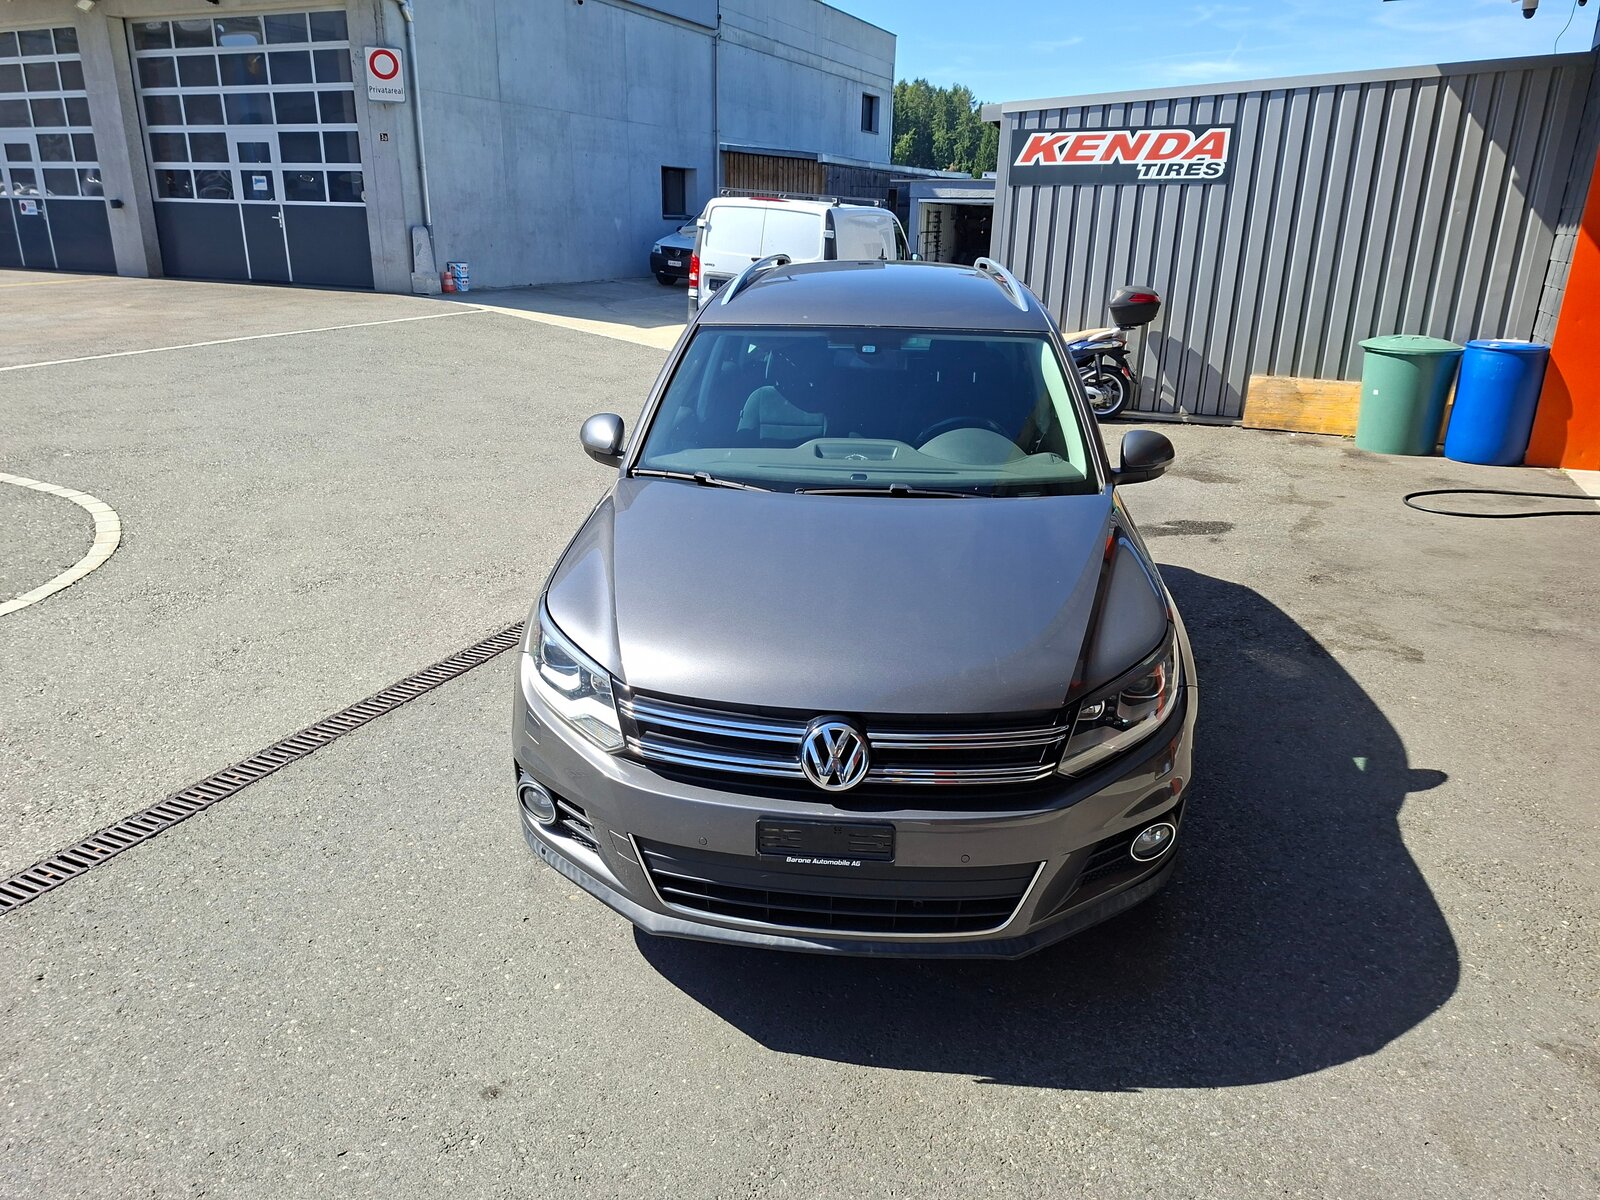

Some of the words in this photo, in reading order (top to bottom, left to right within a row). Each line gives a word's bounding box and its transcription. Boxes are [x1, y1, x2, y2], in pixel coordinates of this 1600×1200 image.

[369, 85, 404, 95] Privatareal
[1015, 128, 1231, 166] KENDA
[1138, 161, 1225, 179] TIRES
[786, 856, 811, 864] Barone
[812, 858, 850, 866] Automobile
